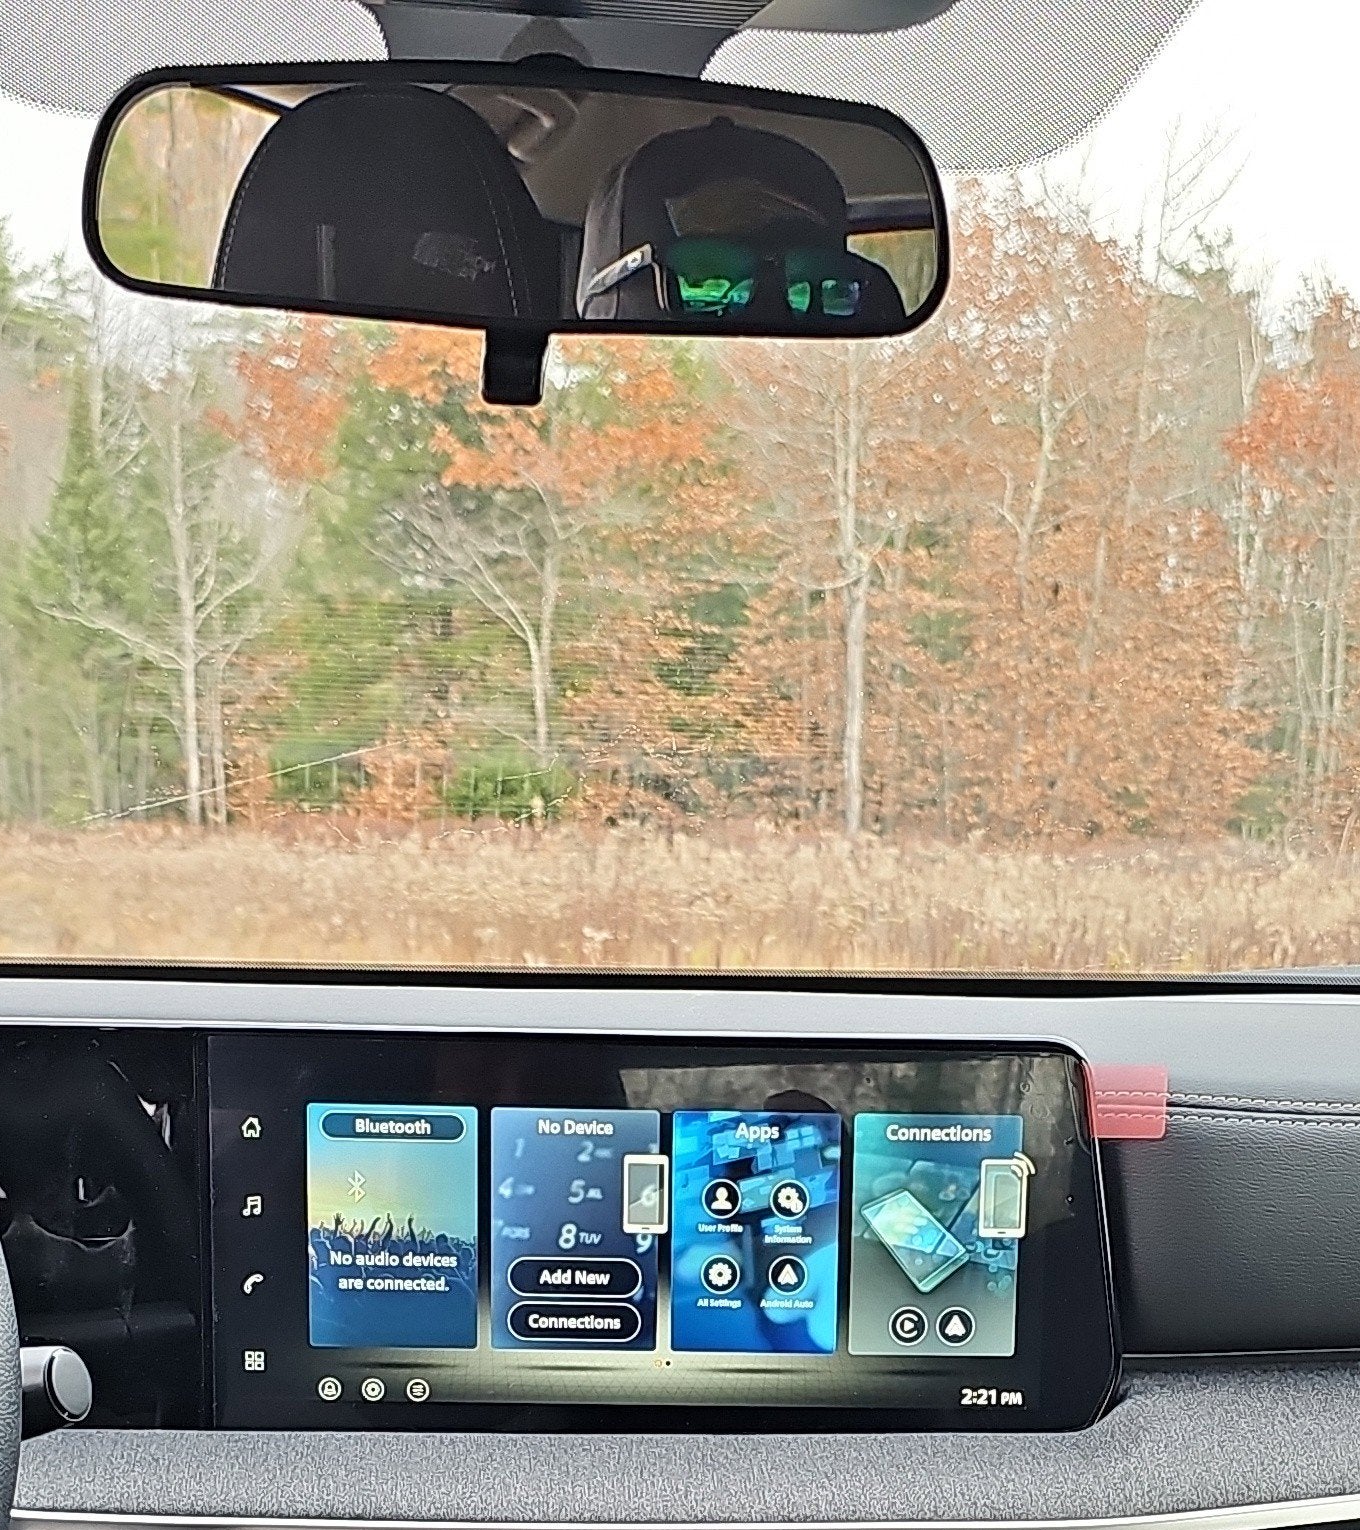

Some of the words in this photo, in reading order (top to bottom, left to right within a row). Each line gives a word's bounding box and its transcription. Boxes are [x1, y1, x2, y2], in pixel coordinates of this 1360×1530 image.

[354, 1118, 432, 1136] Bluetooth
[538, 1119, 560, 1136] No
[563, 1119, 614, 1136] Device
[734, 1122, 780, 1142] Apps
[885, 1124, 992, 1143] Connections
[567, 1179, 586, 1204] 5
[558, 1223, 577, 1250] 8
[578, 1232, 602, 1245] TUV
[698, 1223, 717, 1233] User
[774, 1225, 802, 1235] System
[764, 1235, 812, 1244] Information
[329, 1252, 353, 1268] No
[355, 1252, 400, 1268] audio
[402, 1252, 458, 1269] devices
[338, 1278, 363, 1290] are
[366, 1275, 450, 1291] connected.
[539, 1269, 572, 1286] Add
[574, 1269, 611, 1286] New
[793, 1298, 814, 1308] Auto
[527, 1313, 621, 1330] Connections
[959, 1388, 998, 1406] 2:21
[1000, 1391, 1023, 1406] PM
